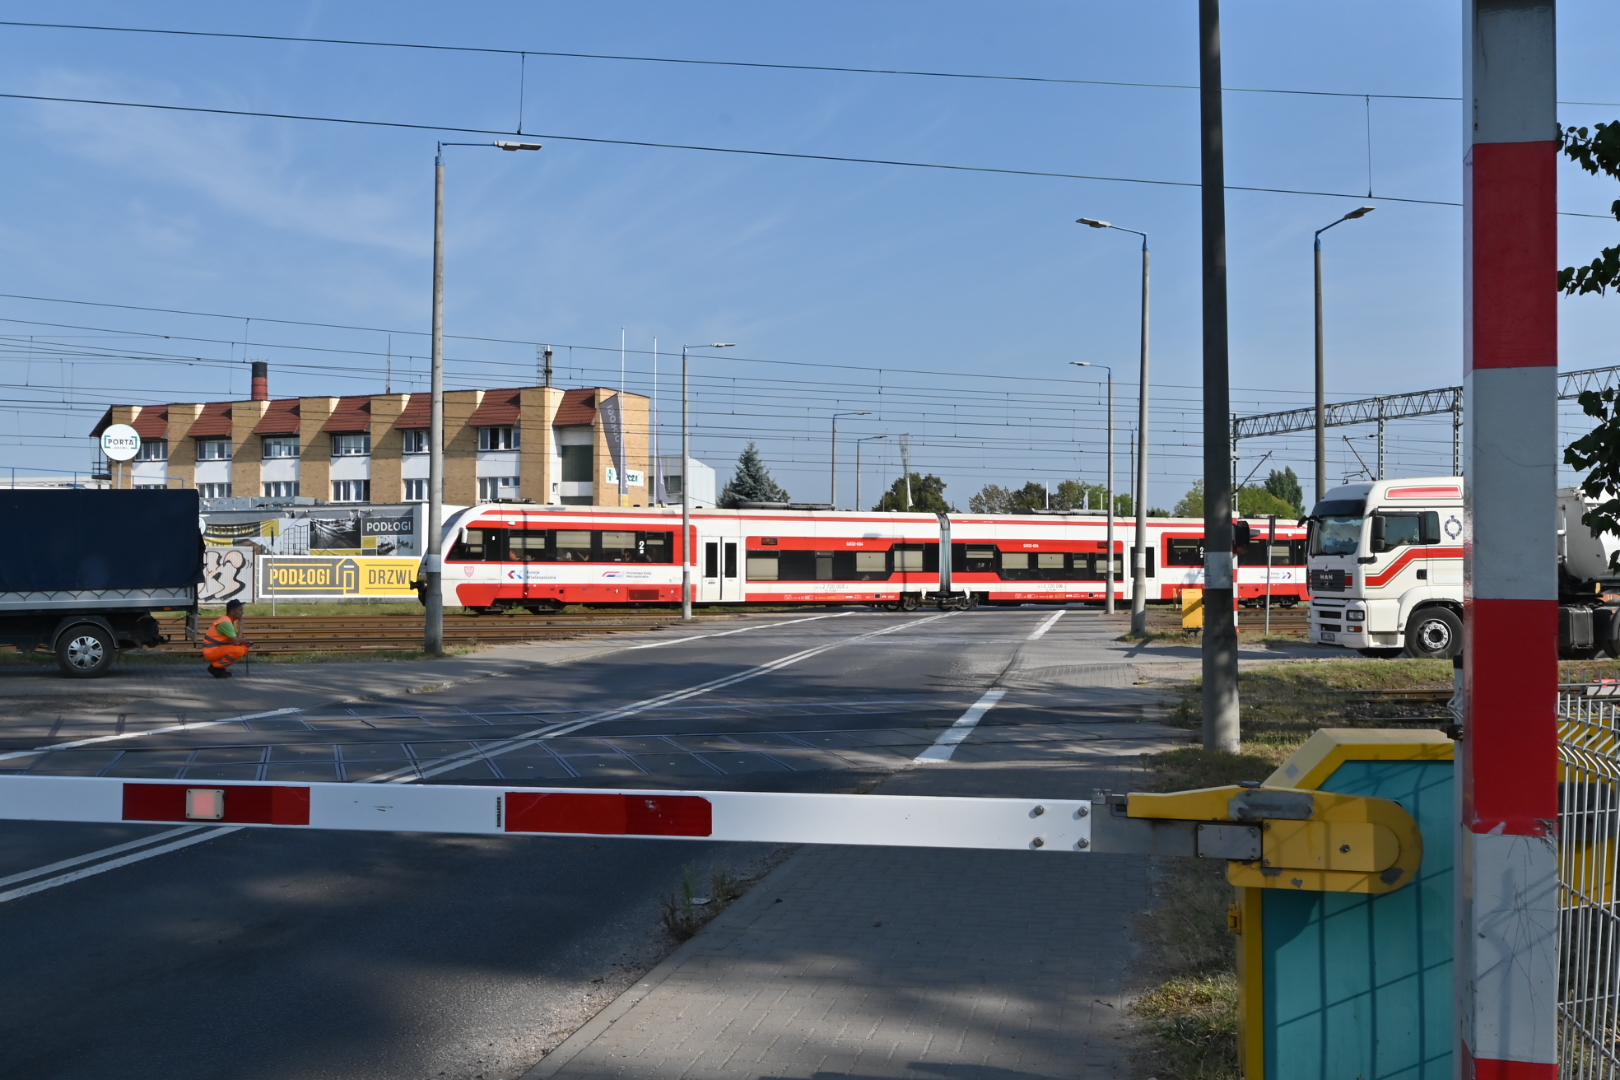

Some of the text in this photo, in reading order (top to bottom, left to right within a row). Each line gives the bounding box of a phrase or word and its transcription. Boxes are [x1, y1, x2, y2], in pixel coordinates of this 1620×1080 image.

[366, 521, 411, 533] PODŁOGI
[638, 540, 645, 550] 2
[1199, 546, 1204, 555] 2
[269, 568, 331, 585] PODŁOGI
[368, 569, 412, 585] DRZWI
